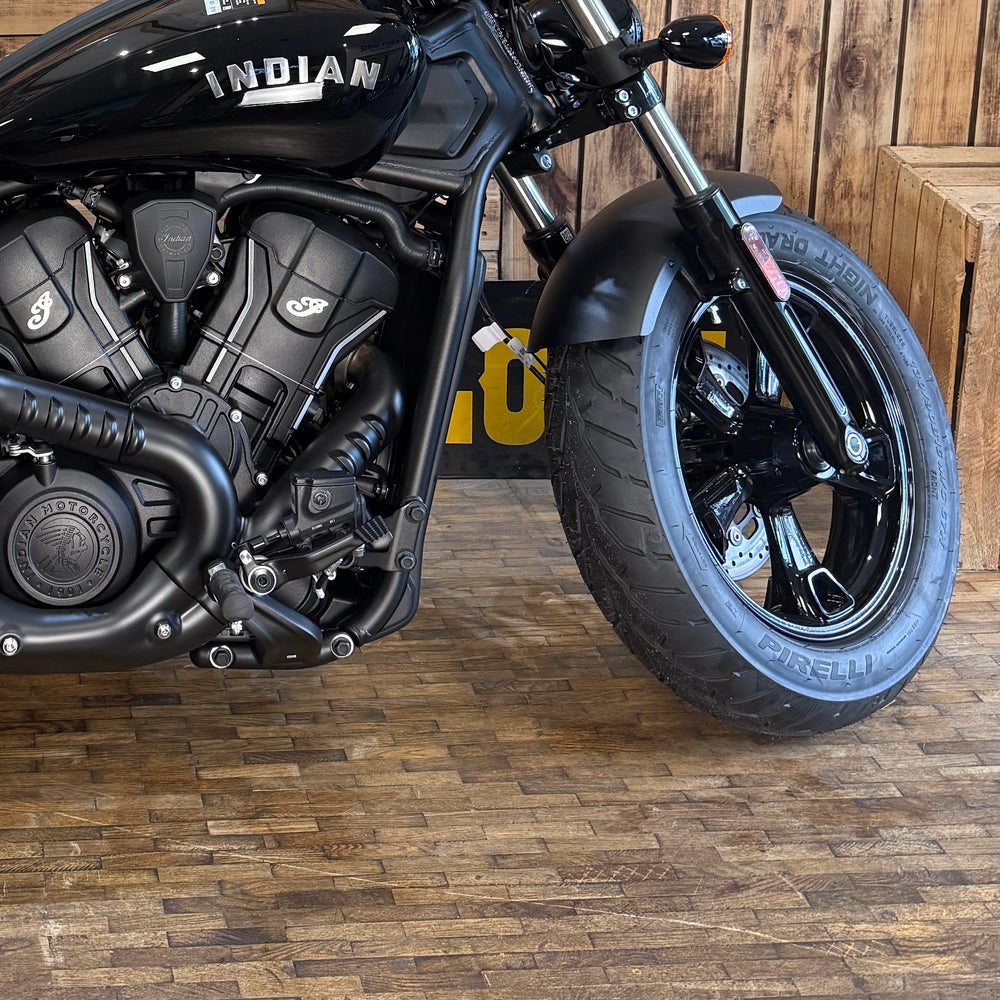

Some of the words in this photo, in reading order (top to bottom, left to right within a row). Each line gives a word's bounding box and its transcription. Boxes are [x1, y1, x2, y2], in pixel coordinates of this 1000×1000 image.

[205, 55, 381, 99] INDIAN
[930, 470, 939, 500] FRONT
[40, 500, 111, 578] MOTORCYCLE
[757, 633, 874, 682] PIRELLI
